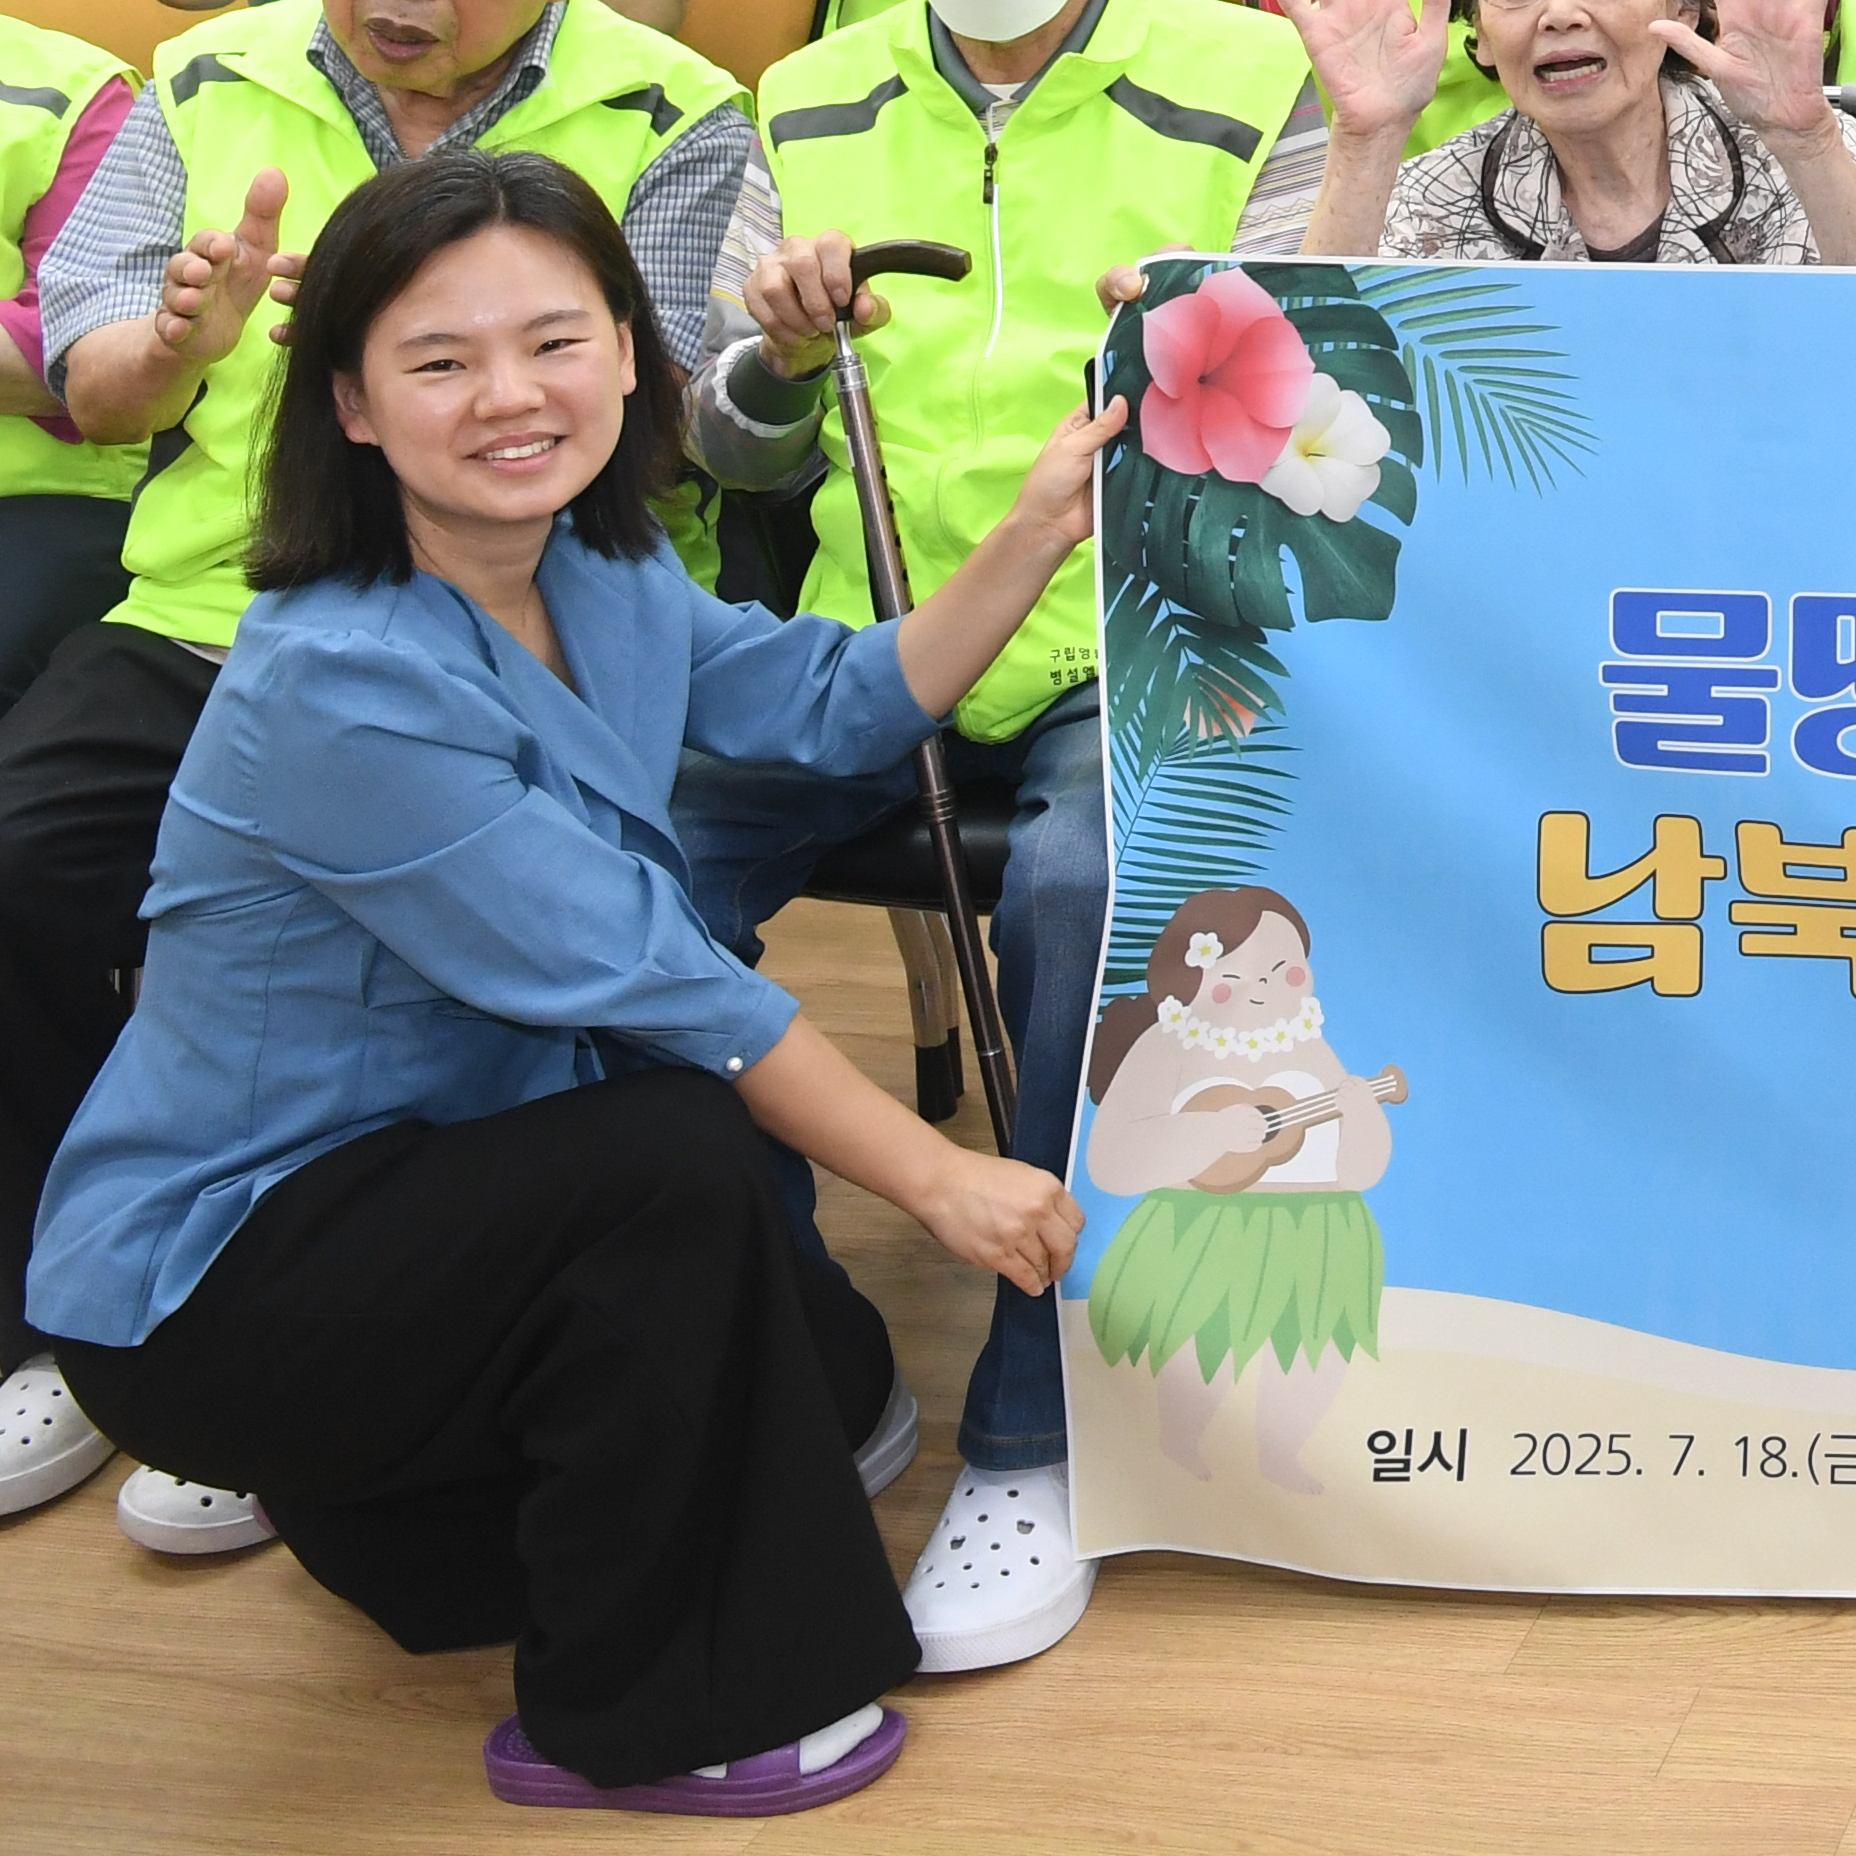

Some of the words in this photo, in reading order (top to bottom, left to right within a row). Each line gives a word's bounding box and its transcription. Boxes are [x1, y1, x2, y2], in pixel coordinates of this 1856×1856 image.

[1365, 1428, 1468, 1483] 일시
[1509, 1431, 1644, 1477] 2025.
[1667, 1433, 1706, 1478] 7.
